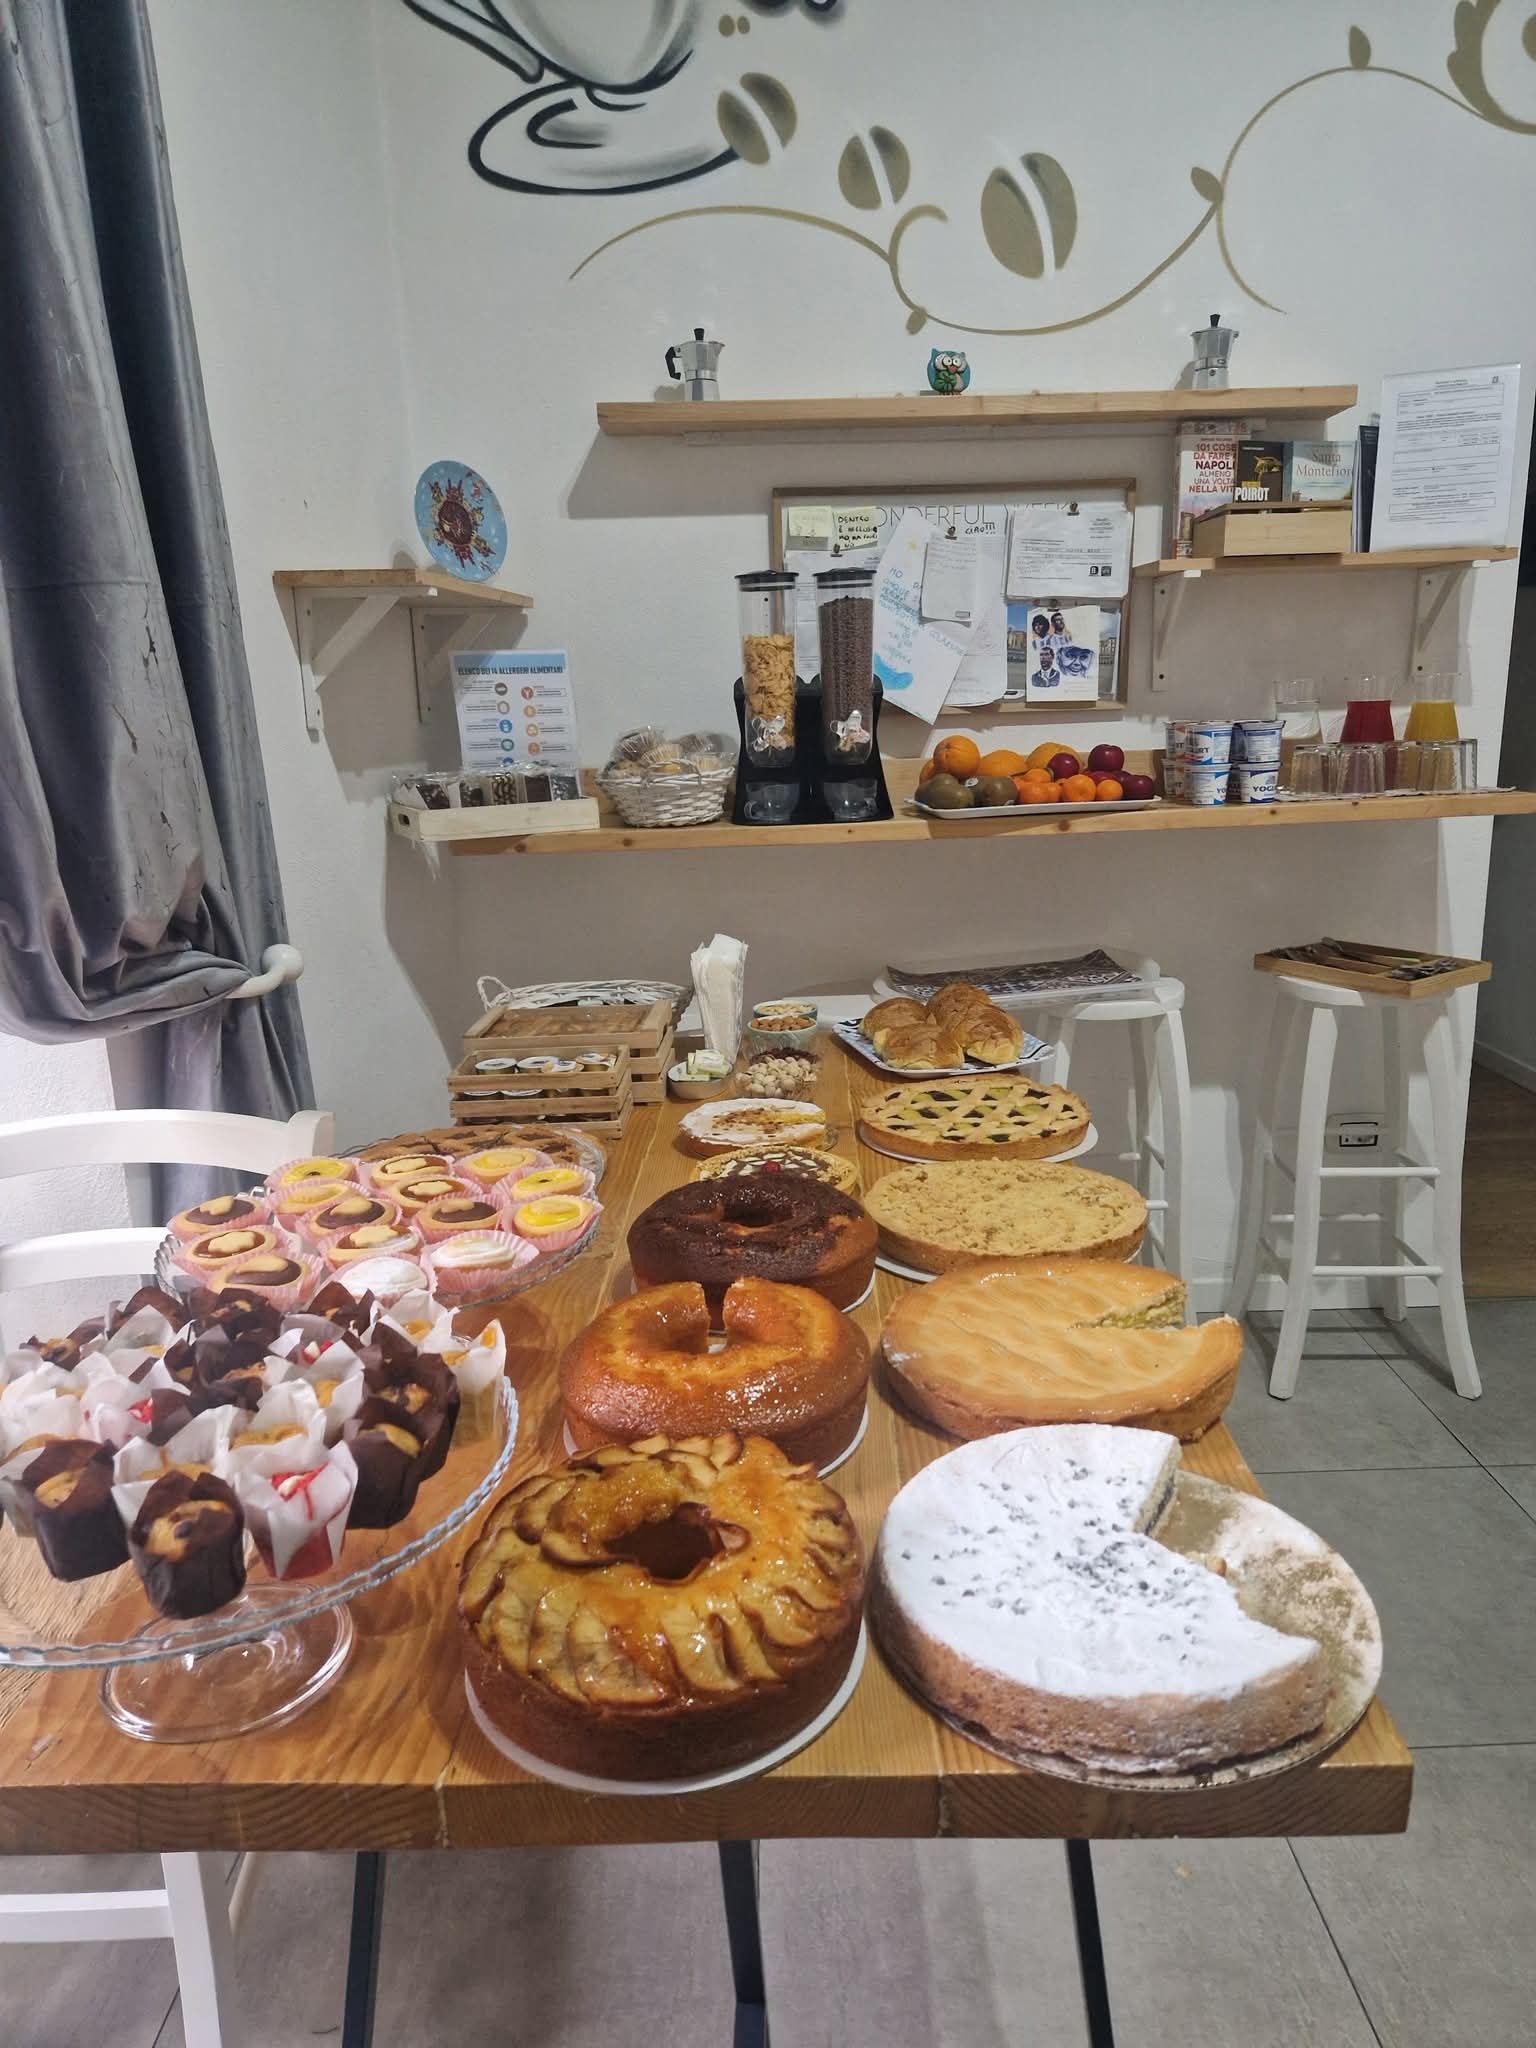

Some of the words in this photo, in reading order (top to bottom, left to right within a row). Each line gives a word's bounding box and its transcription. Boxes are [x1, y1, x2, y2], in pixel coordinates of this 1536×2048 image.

[1212, 443, 1237, 452] COSE
[1193, 452, 1205, 460] DA
[1208, 452, 1230, 460] FARE
[1312, 452, 1341, 463] Santa
[1195, 461, 1235, 470] NAPOLI
[1296, 463, 1352, 477] Montefior
[1199, 470, 1231, 478] ALMENO
[1189, 485, 1218, 493] NELLA
[1220, 485, 1234, 493] VIT
[1234, 487, 1269, 501] POIROT
[458, 667, 480, 676] ELENCO
[498, 666, 529, 675] ALLERGENI
[530, 665, 563, 674] ALIMENTARI
